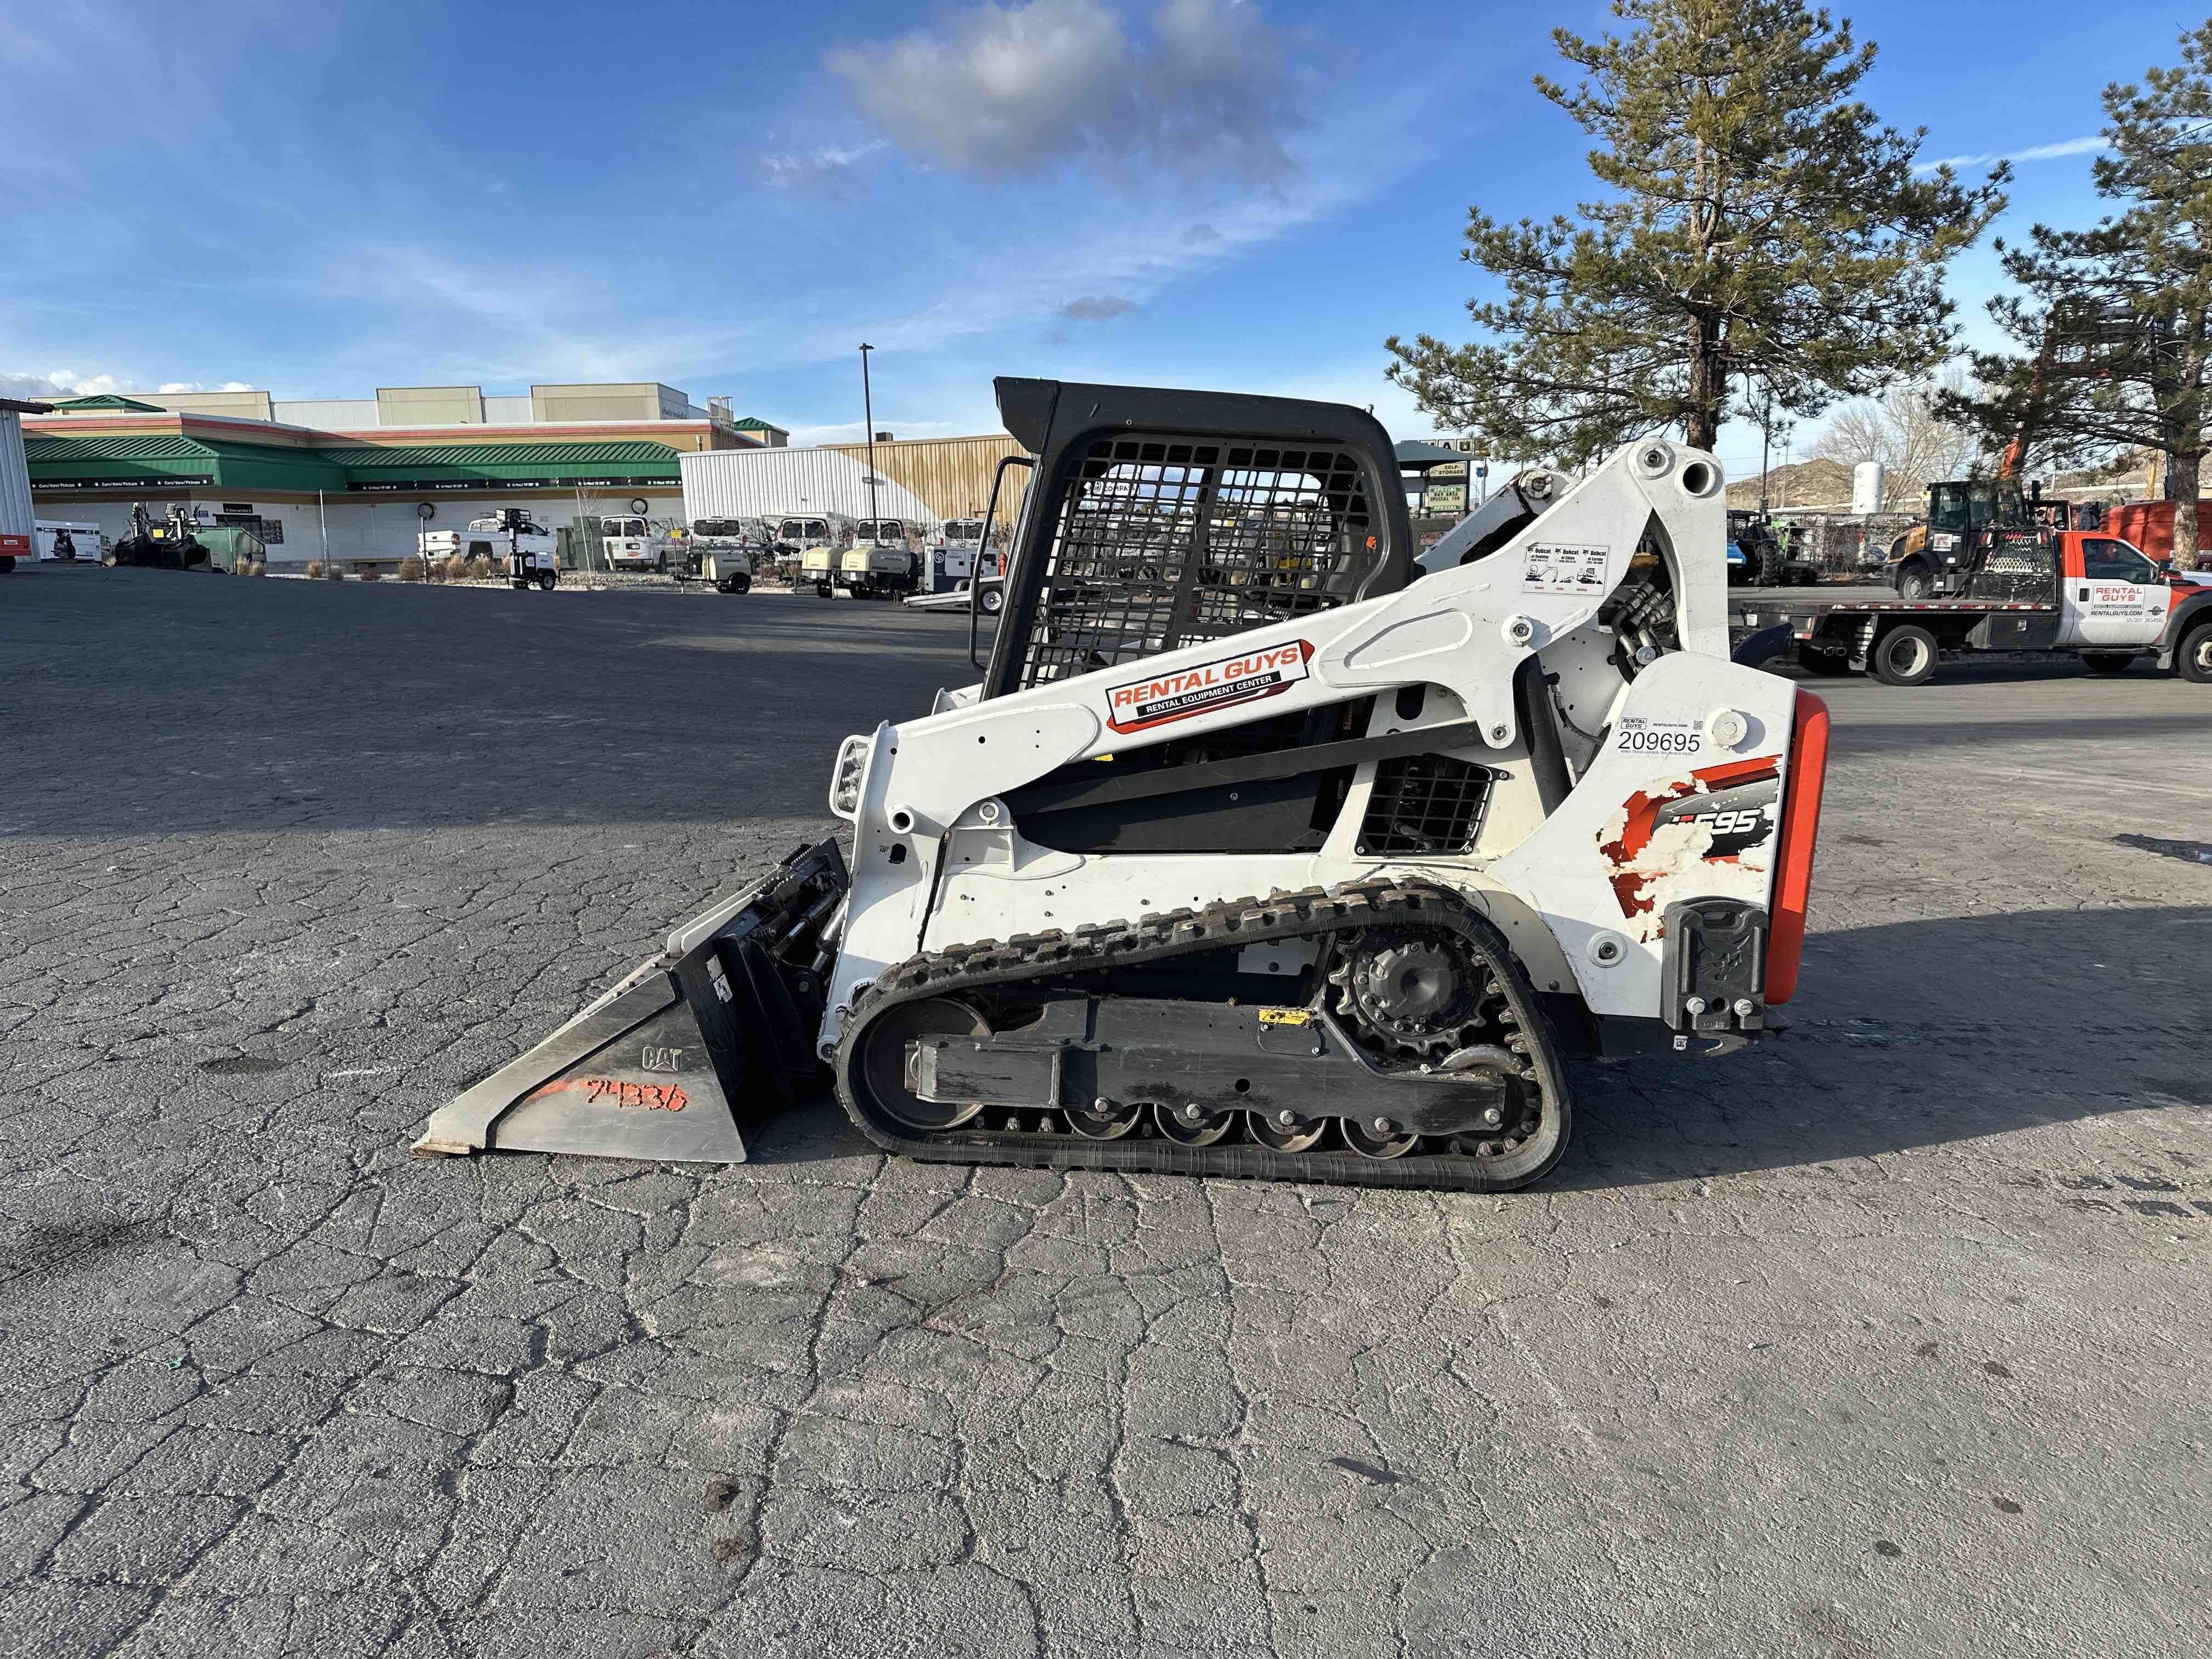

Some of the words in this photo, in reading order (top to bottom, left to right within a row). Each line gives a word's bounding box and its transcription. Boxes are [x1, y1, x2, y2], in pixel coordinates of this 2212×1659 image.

[1114, 668, 1219, 708] RENTAL
[1224, 647, 1298, 679] GUYS
[1146, 698, 1181, 713] RENTAL
[1182, 685, 1234, 704] EQUIPMENT
[1237, 675, 1272, 691] CENTER
[1618, 731, 1700, 752] 209695
[1672, 809, 1762, 835] 595
[642, 1046, 683, 1071] CAT
